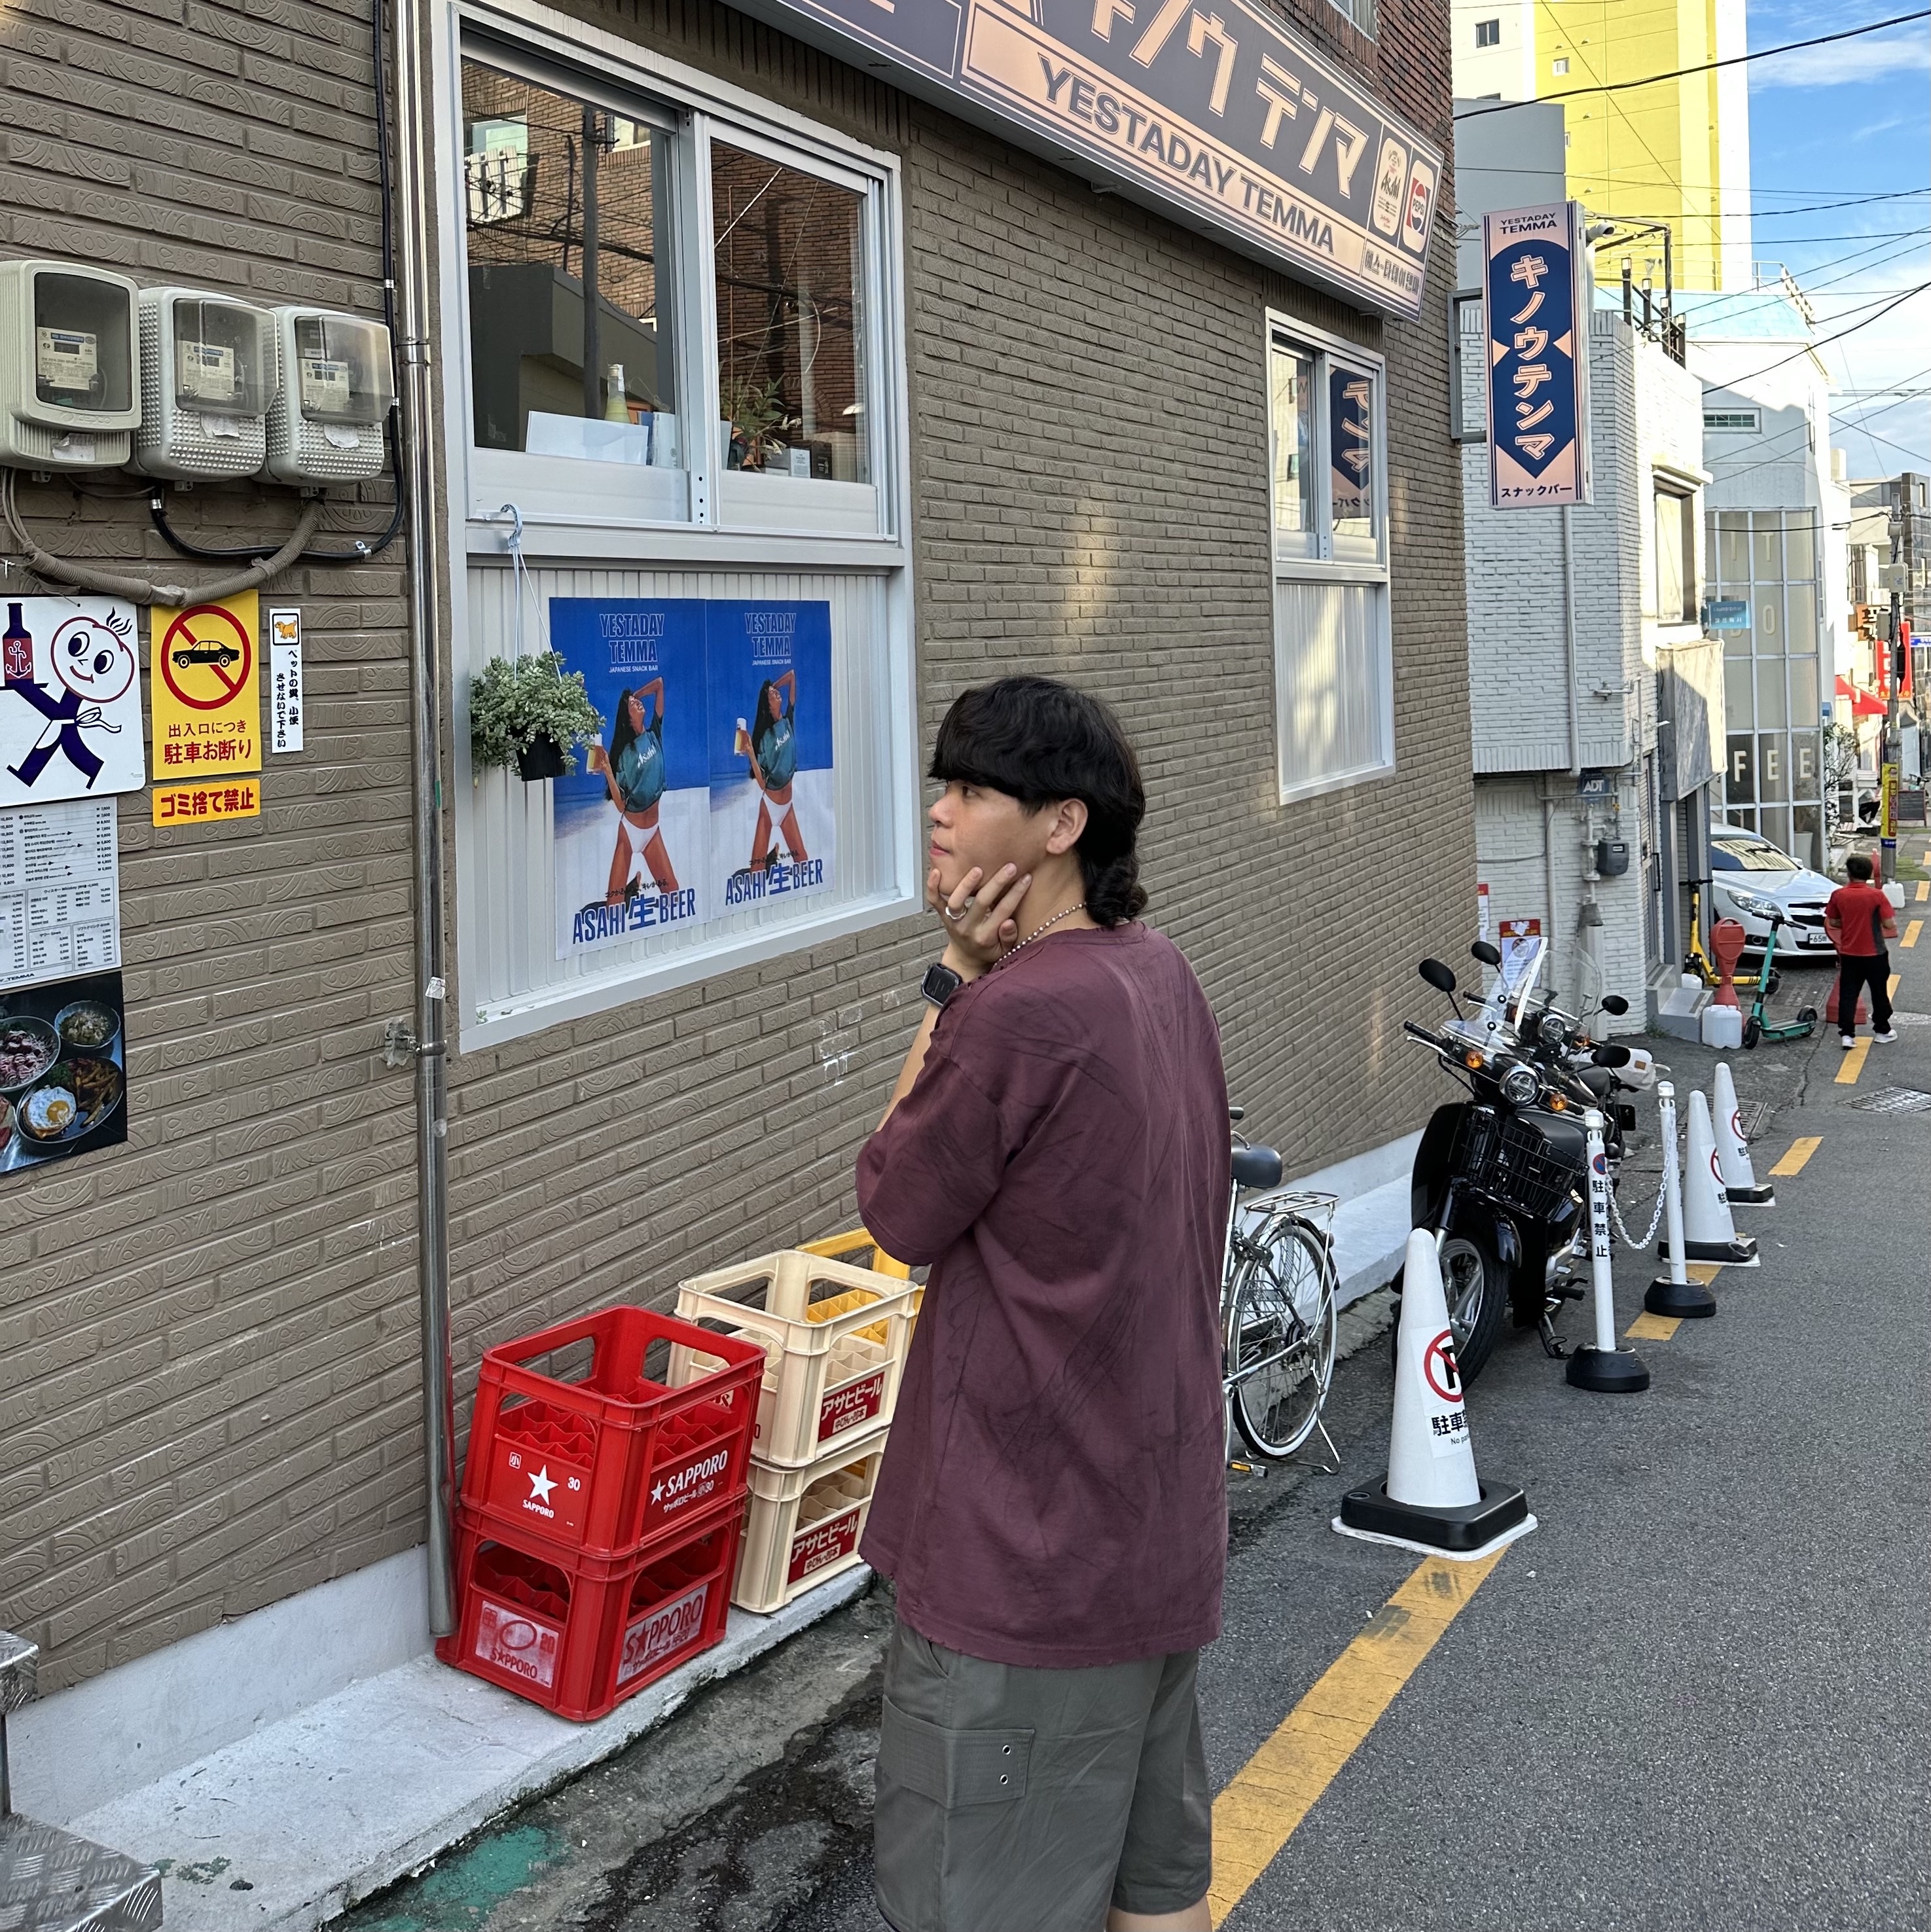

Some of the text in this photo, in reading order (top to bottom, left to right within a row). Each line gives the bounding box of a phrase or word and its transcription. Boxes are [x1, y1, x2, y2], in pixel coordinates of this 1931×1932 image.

[1038, 52, 1334, 255] YESTADAY TEMMA
[1412, 198, 1425, 216] PEPSI
[1500, 213, 1556, 226] YESTADAY
[1500, 220, 1557, 235] TEMMA
[1510, 254, 1555, 460] キノウテンマ
[1501, 483, 1572, 498] スナックバー
[599, 613, 665, 637] YESTADAY
[744, 612, 797, 634] YESTADAY
[608, 639, 658, 664] TEMMA
[751, 635, 791, 658] TEMMA
[276, 672, 287, 748] させないで下さい
[168, 719, 247, 738] 出入口につき
[774, 730, 791, 751] Asahi
[164, 738, 251, 765] 駐車お断り
[1583, 779, 1604, 793] ADT
[160, 787, 255, 818] ゴミ捨て禁止
[725, 858, 823, 906] ASAHI 生 BEER
[573, 887, 696, 944] ASAHI 生 BEER
[1592, 1180, 1608, 1258] 駐車禁止
[821, 1376, 883, 1422] アサヒビール
[567, 1476, 581, 1492] 30
[666, 1449, 728, 1497] SAPPORO
[522, 1498, 555, 1519] SAPPORO
[791, 1514, 858, 1564] アサヒビール
